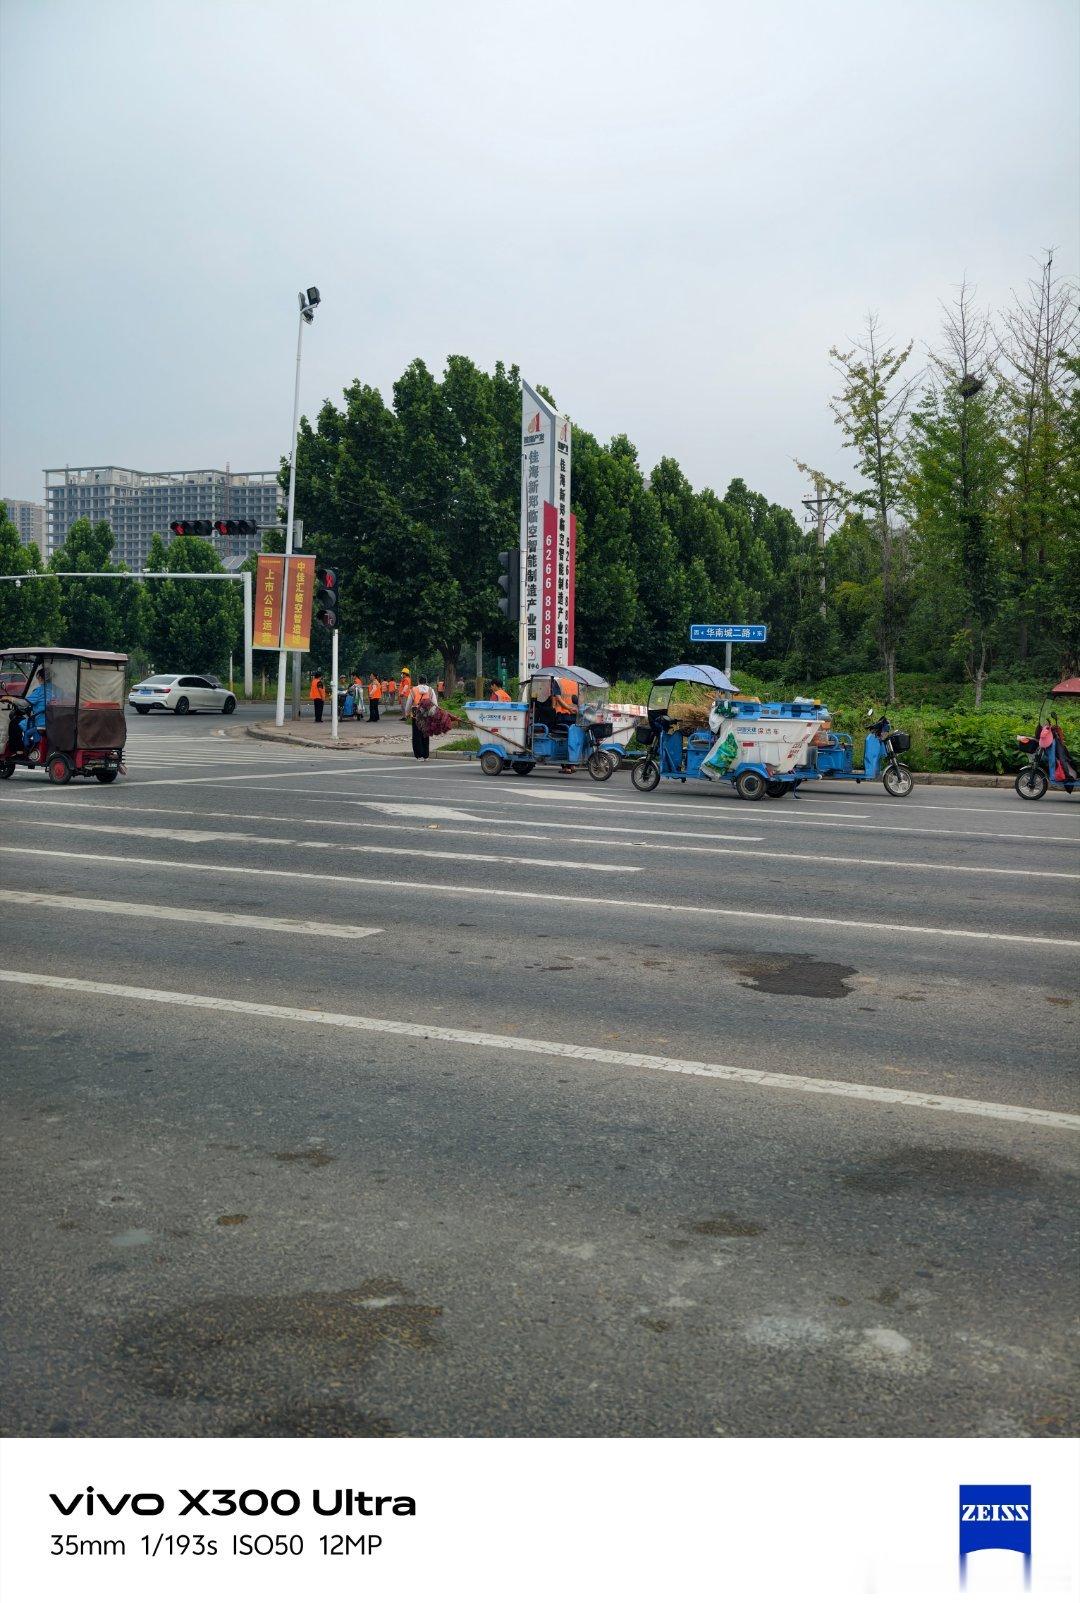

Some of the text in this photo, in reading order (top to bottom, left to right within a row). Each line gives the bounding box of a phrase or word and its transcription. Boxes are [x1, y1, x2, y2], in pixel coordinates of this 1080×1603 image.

[527, 449, 540, 641] 佳海新郑临空智能制造产业园
[706, 627, 751, 638] 华南城二路
